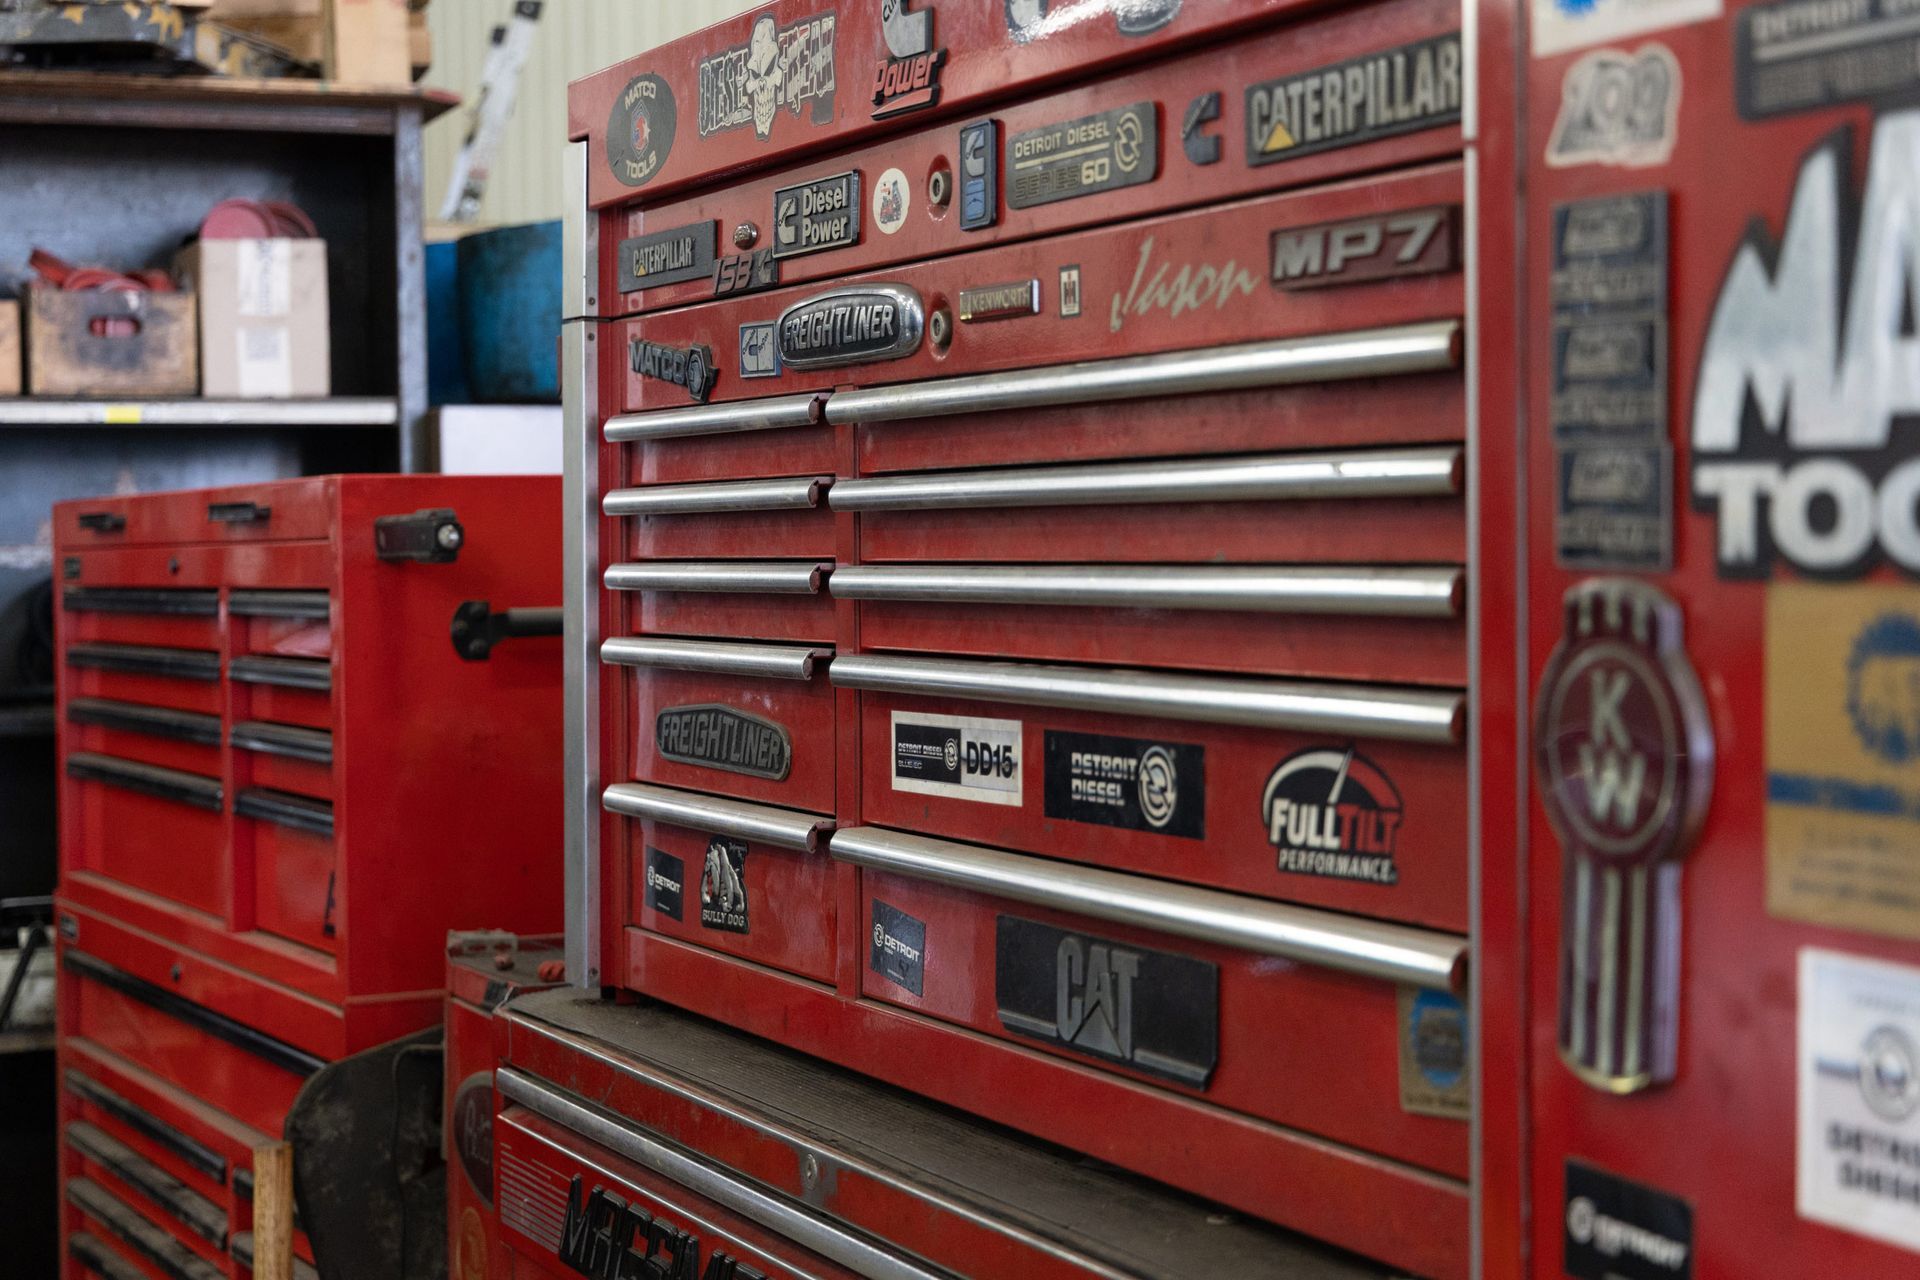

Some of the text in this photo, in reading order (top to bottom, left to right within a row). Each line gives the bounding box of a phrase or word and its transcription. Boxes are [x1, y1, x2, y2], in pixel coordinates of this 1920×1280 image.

[624, 81, 657, 111] MATCO
[871, 52, 938, 102] Power
[1251, 41, 1461, 151] CATERPILLAR
[1015, 121, 1110, 158] DETROIT DIESEL
[626, 150, 657, 179] TOOLS
[1015, 157, 1110, 201] SERIES 60
[803, 178, 847, 216] Diesel
[802, 216, 848, 246] Power
[1272, 211, 1441, 280] MP7
[633, 237, 692, 277] CATERPILLAR
[1110, 234, 1262, 333] Jason
[782, 304, 895, 353] FREIGHTLINER
[629, 340, 687, 387] MATCO
[661, 712, 781, 770] FREIGHTLINER
[965, 740, 1013, 779] DD15
[1071, 752, 1137, 781] DETROIT
[1071, 778, 1125, 806] DIESEL
[655, 873, 681, 894] DETROIT
[1278, 847, 1393, 883] PERFORMANCE
[702, 908, 745, 927] BULLY DOG
[884, 933, 920, 962] DETROIT
[1056, 936, 1140, 1061] CAT
